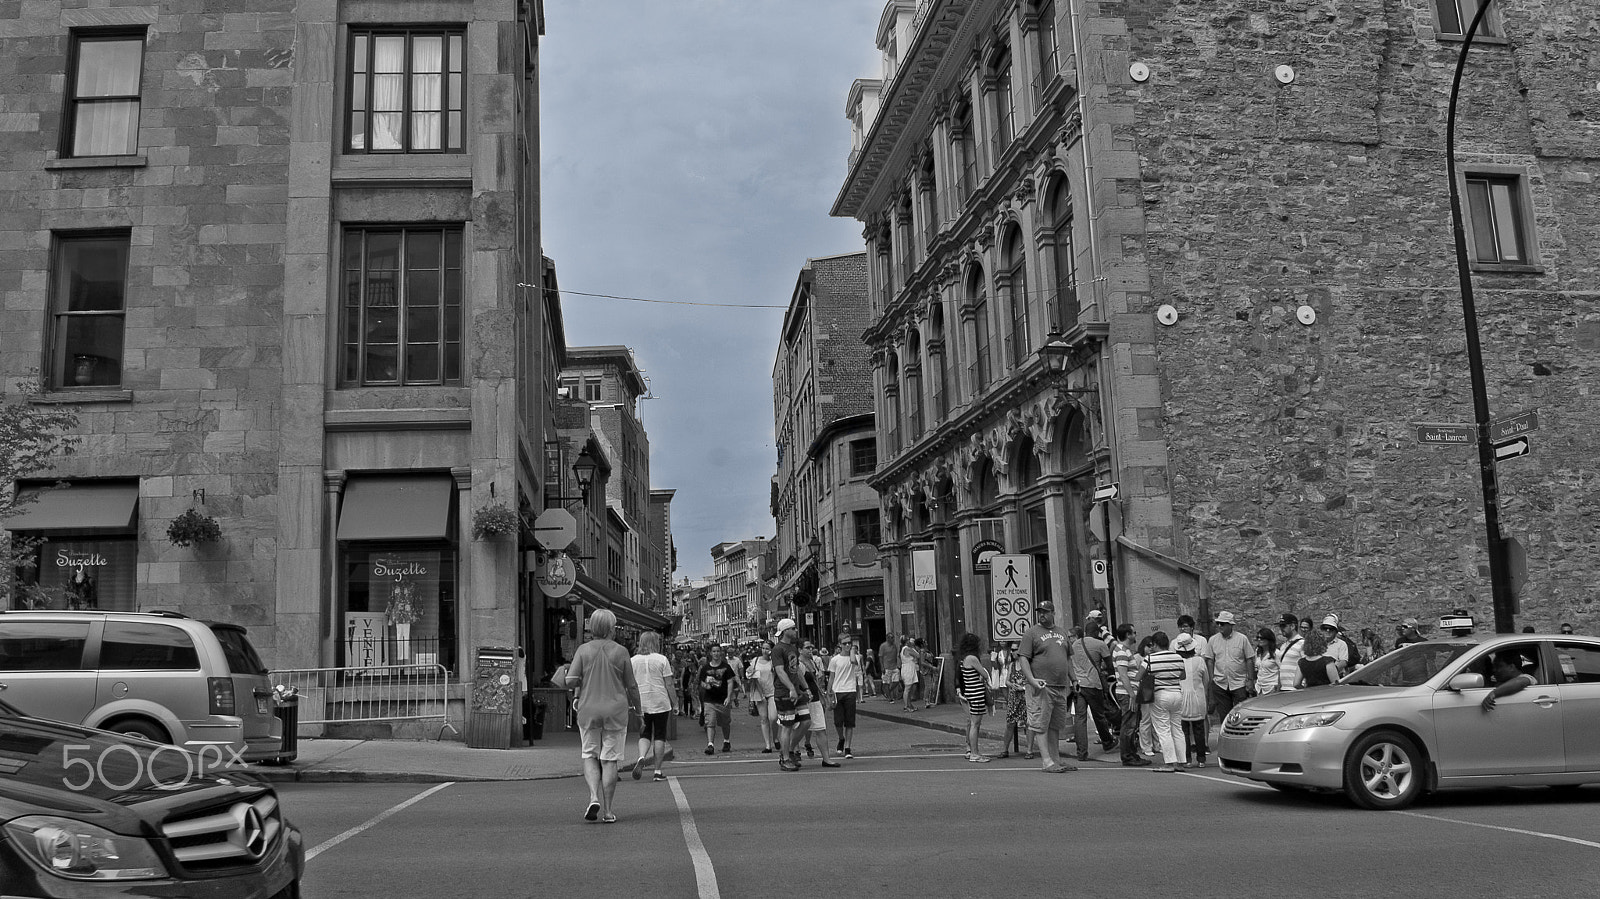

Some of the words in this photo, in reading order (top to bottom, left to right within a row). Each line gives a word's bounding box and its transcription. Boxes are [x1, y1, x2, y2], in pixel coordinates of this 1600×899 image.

[1425, 432, 1468, 441] Saint-Laurent
[56, 549, 108, 573] Suzette
[374, 558, 427, 582] Suzette
